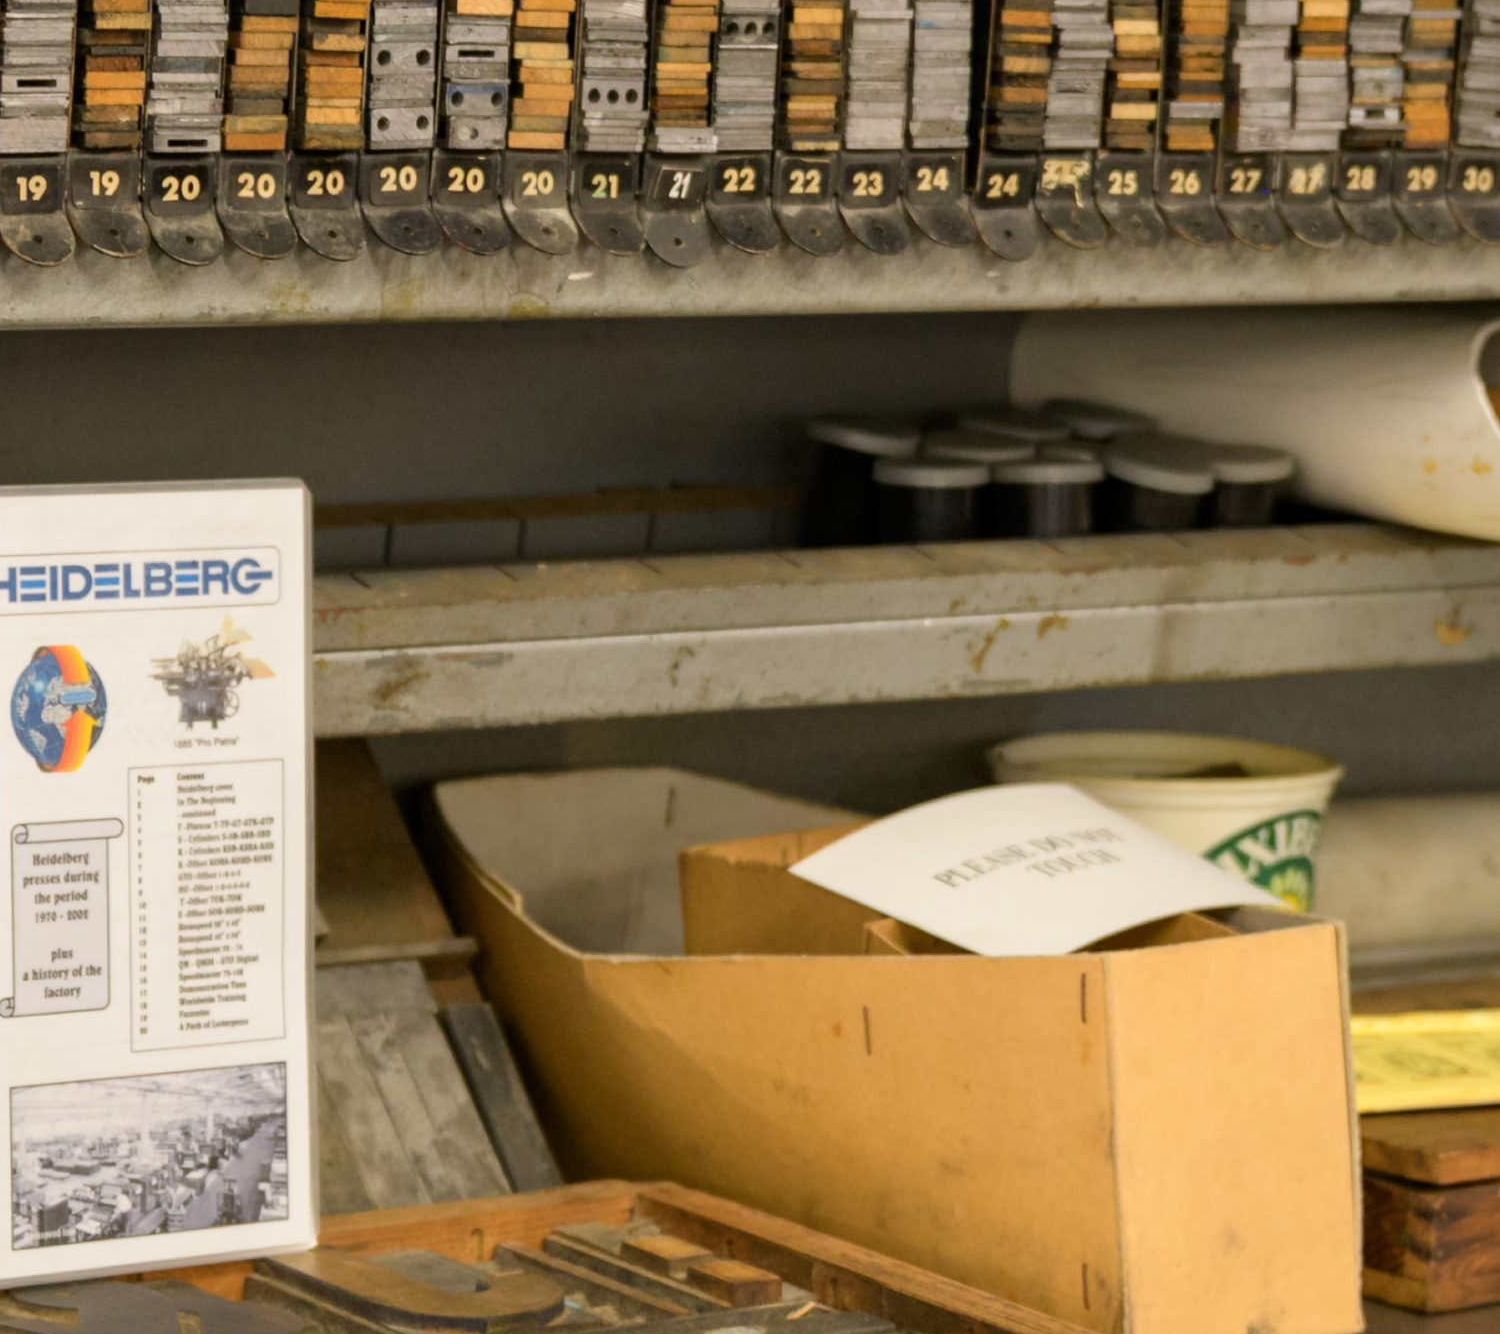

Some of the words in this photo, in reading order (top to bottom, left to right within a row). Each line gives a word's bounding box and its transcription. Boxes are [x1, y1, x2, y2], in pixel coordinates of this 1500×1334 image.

[16, 174, 48, 202] 19
[89, 169, 121, 197] 19
[161, 174, 201, 202] 20
[237, 171, 277, 200] 20
[306, 169, 346, 197] 20
[379, 165, 418, 193] 20
[447, 166, 486, 194] 20
[521, 169, 554, 197] 20
[591, 173, 620, 199] 21
[669, 169, 694, 200] 21
[722, 167, 756, 194] 22
[788, 168, 822, 195] 22
[852, 170, 886, 197] 23
[915, 165, 950, 193] 24
[987, 172, 1020, 199] 24
[1108, 168, 1139, 196] 25
[1169, 168, 1201, 196] 26
[1229, 168, 1264, 194] 27
[1345, 165, 1378, 192] 28
[1406, 165, 1438, 192] 29
[1462, 166, 1495, 193] 30
[32, 852, 90, 866] Heidelberg
[932, 843, 1033, 889] PLEASE
[1028, 832, 1075, 857] DO
[1026, 846, 1122, 879] TOUCH
[23, 872, 61, 888] presses
[64, 870, 99, 884] during
[34, 892, 51, 905] the
[54, 889, 88, 906] period
[51, 947, 74, 963] plus
[22, 971, 29, 981] a
[32, 968, 69, 983] history
[72, 965, 82, 977] of
[85, 965, 102, 976] the
[44, 986, 82, 1000] factory
